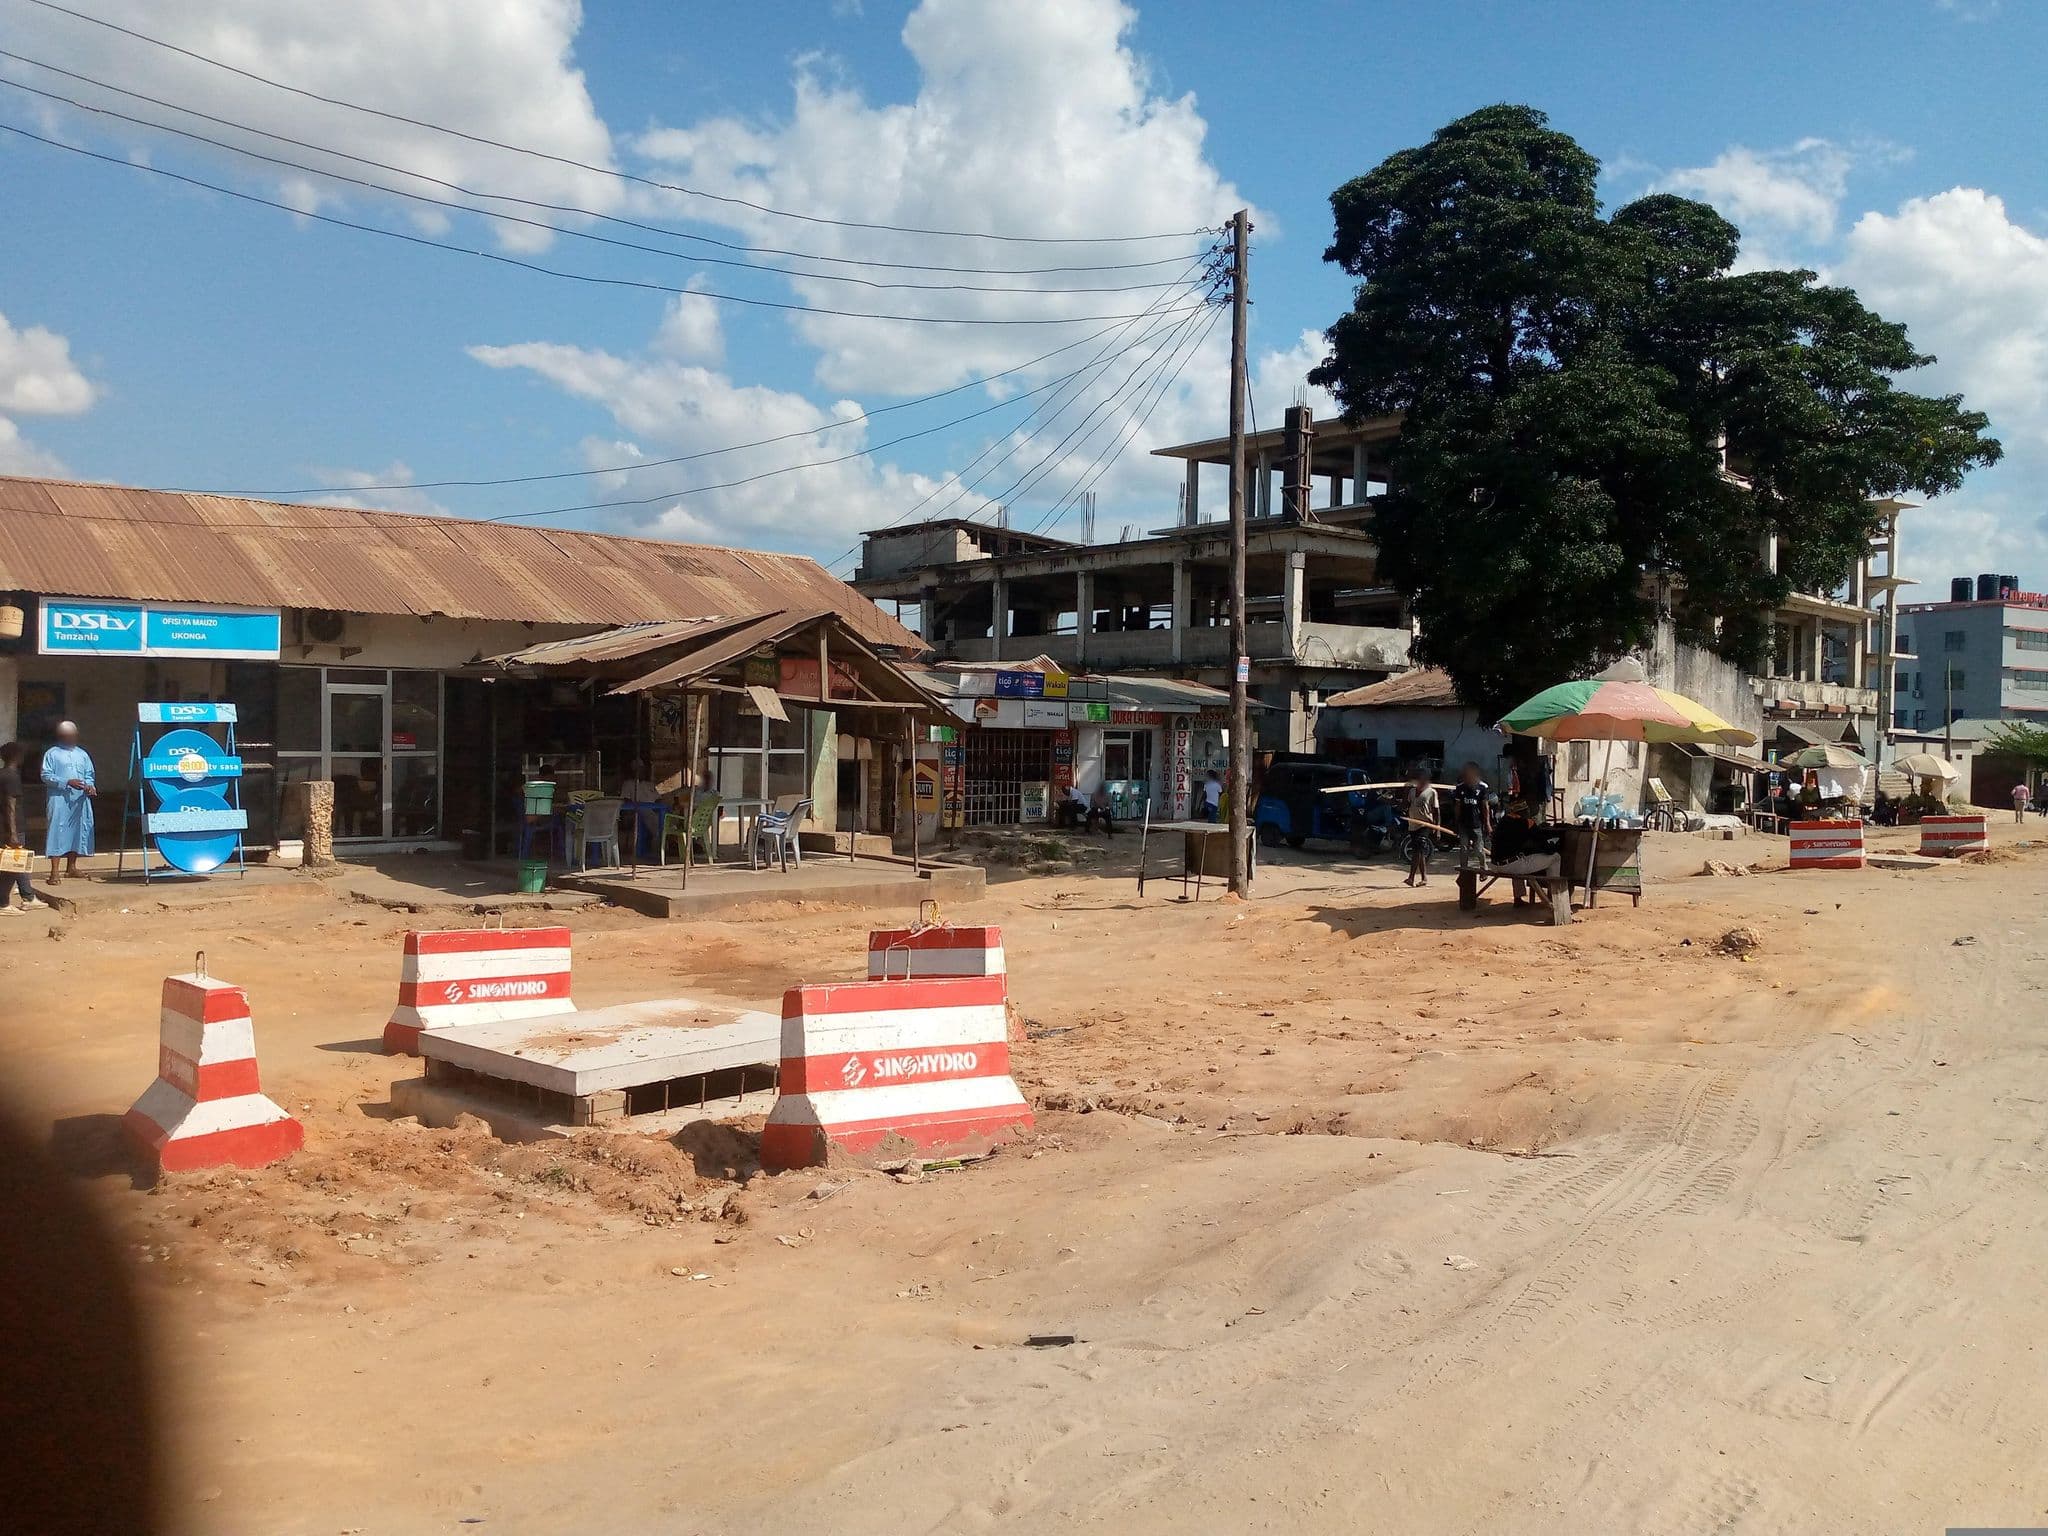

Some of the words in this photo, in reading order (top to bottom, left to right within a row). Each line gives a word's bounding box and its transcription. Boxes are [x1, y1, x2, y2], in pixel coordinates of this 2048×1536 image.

[162, 617, 181, 626] OFISI
[182, 618, 192, 626] YA
[192, 618, 218, 627] MAUZO
[54, 631, 99, 641] Tanzania
[171, 632, 206, 640] UKONGA
[1177, 731, 1187, 765] DUKA
[1176, 773, 1186, 811] DAWA
[1026, 807, 1043, 816] NMB
[468, 980, 548, 998] SINOHYDRO
[873, 1051, 977, 1079] SINOHYDRO
